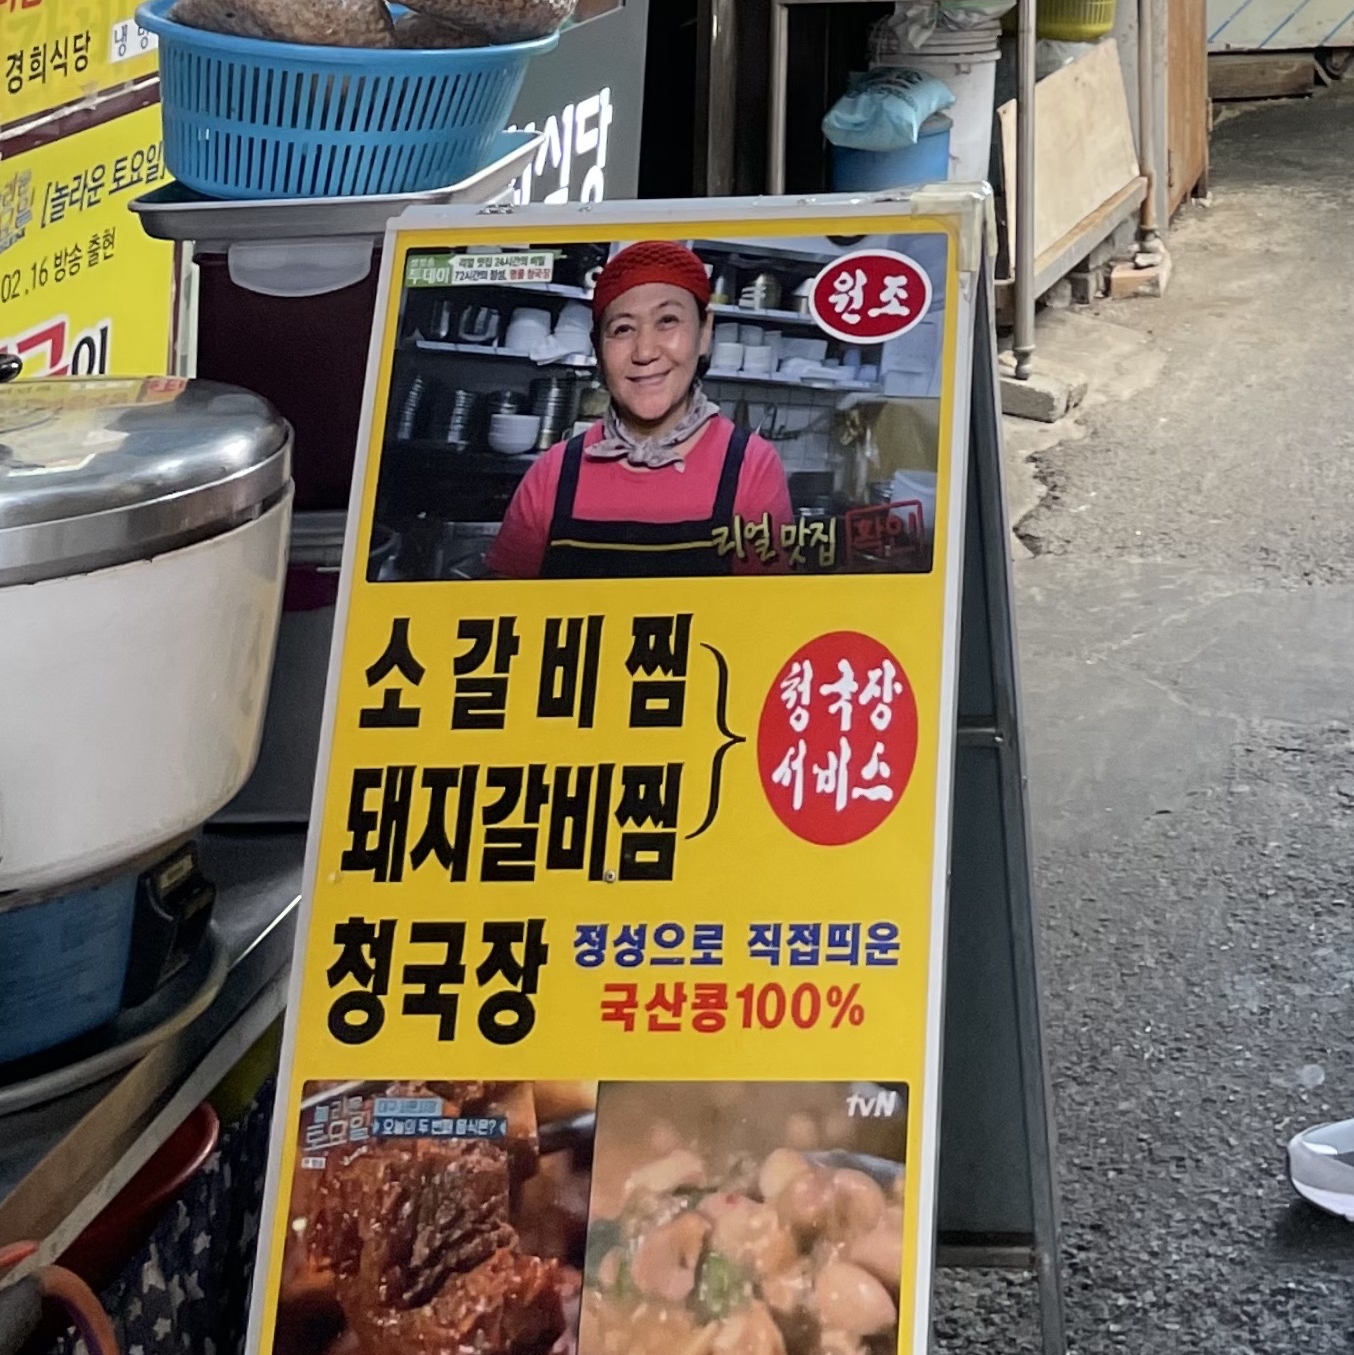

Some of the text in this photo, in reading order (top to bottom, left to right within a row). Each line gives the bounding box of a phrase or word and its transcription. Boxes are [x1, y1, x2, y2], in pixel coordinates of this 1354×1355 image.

[5, 29, 91, 95] 경희식당
[40, 164, 106, 229] [놀라운
[107, 140, 166, 196] 토요일]
[53, 243, 83, 283] 방송
[87, 226, 117, 268] 출현
[828, 268, 911, 325] 원조
[711, 511, 777, 563] 리얼
[780, 515, 838, 568] 맛집
[358, 612, 694, 731] 소갈비찜
[779, 657, 904, 733] 청국장
[771, 735, 894, 812] 서비스
[338, 761, 685, 883] 돼지갈비찜
[571, 920, 901, 969] 정성으로 직접띄운
[325, 917, 549, 1046] 청국장
[599, 980, 866, 1034] 국산콩100%
[845, 1090, 897, 1117] tvN
